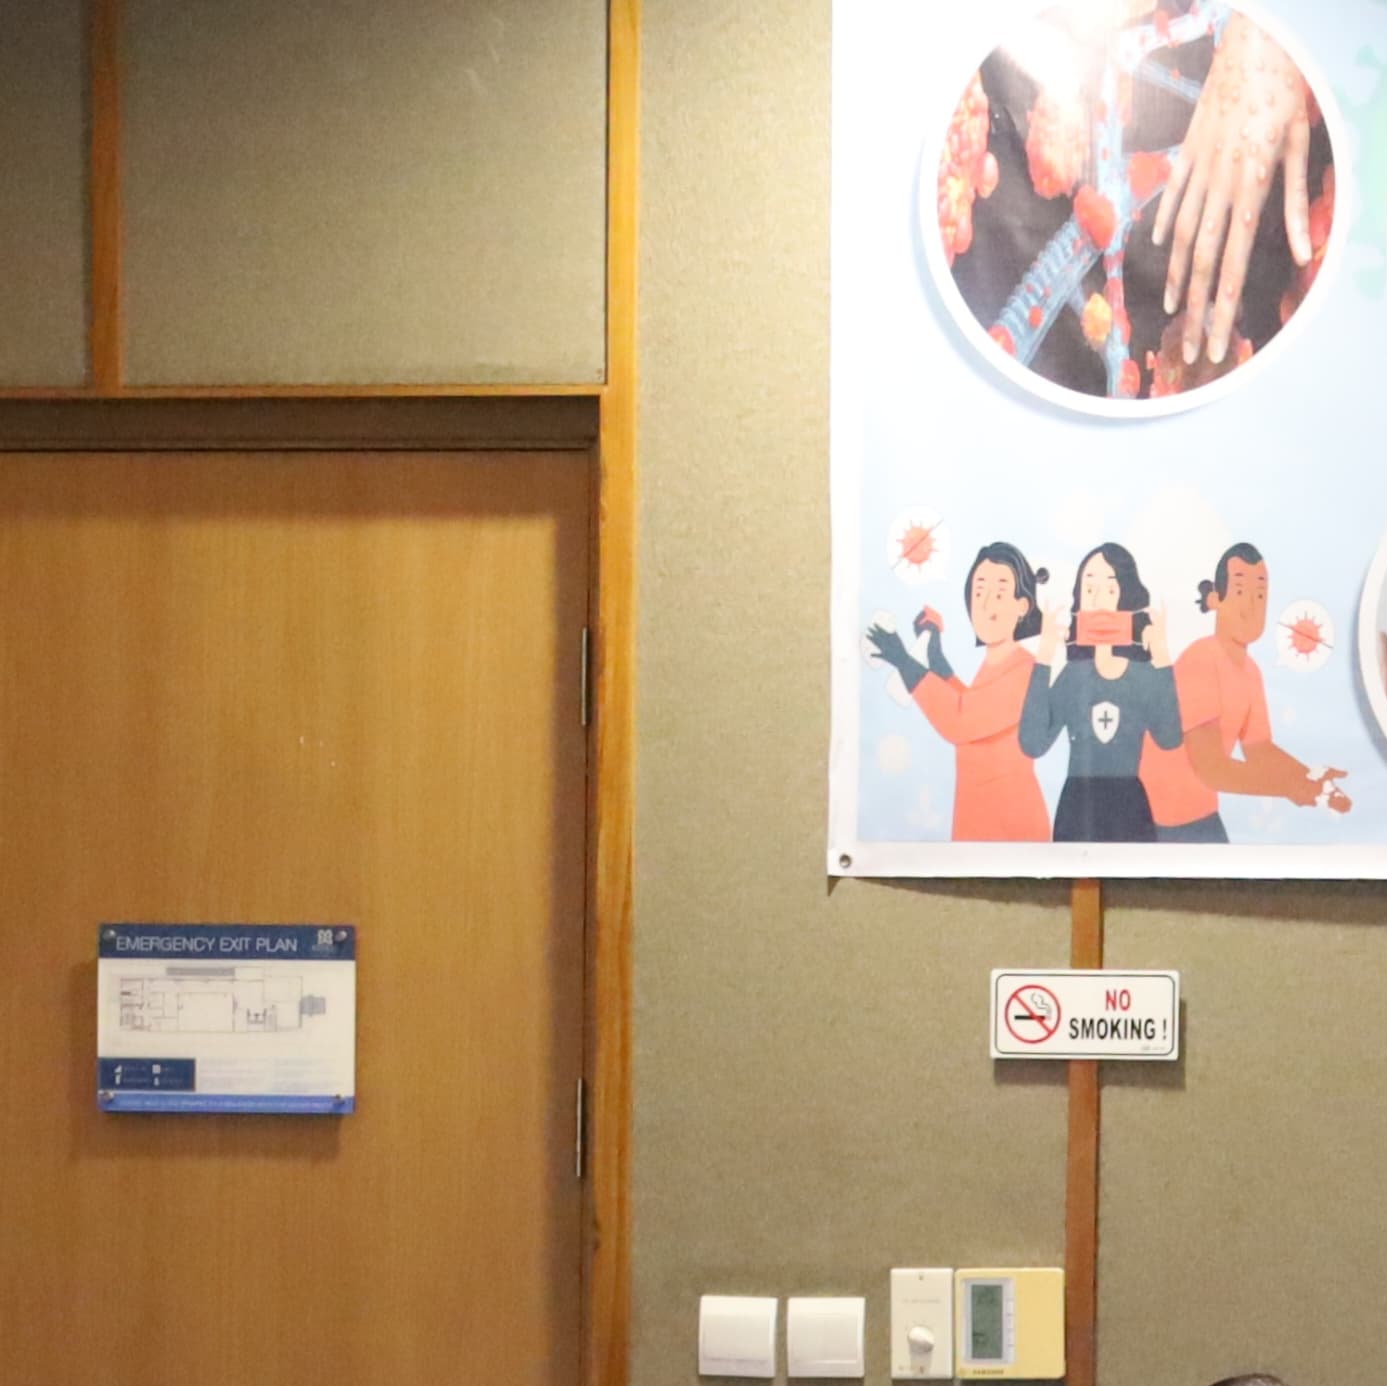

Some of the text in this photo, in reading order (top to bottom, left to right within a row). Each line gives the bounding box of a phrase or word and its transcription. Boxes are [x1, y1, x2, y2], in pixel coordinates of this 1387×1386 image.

[115, 936, 215, 952] EMERGENCY
[219, 937, 252, 952] EXIT
[256, 938, 298, 952] PLAN
[1105, 989, 1132, 1012] NO
[1068, 1017, 1156, 1041] SMOKING
